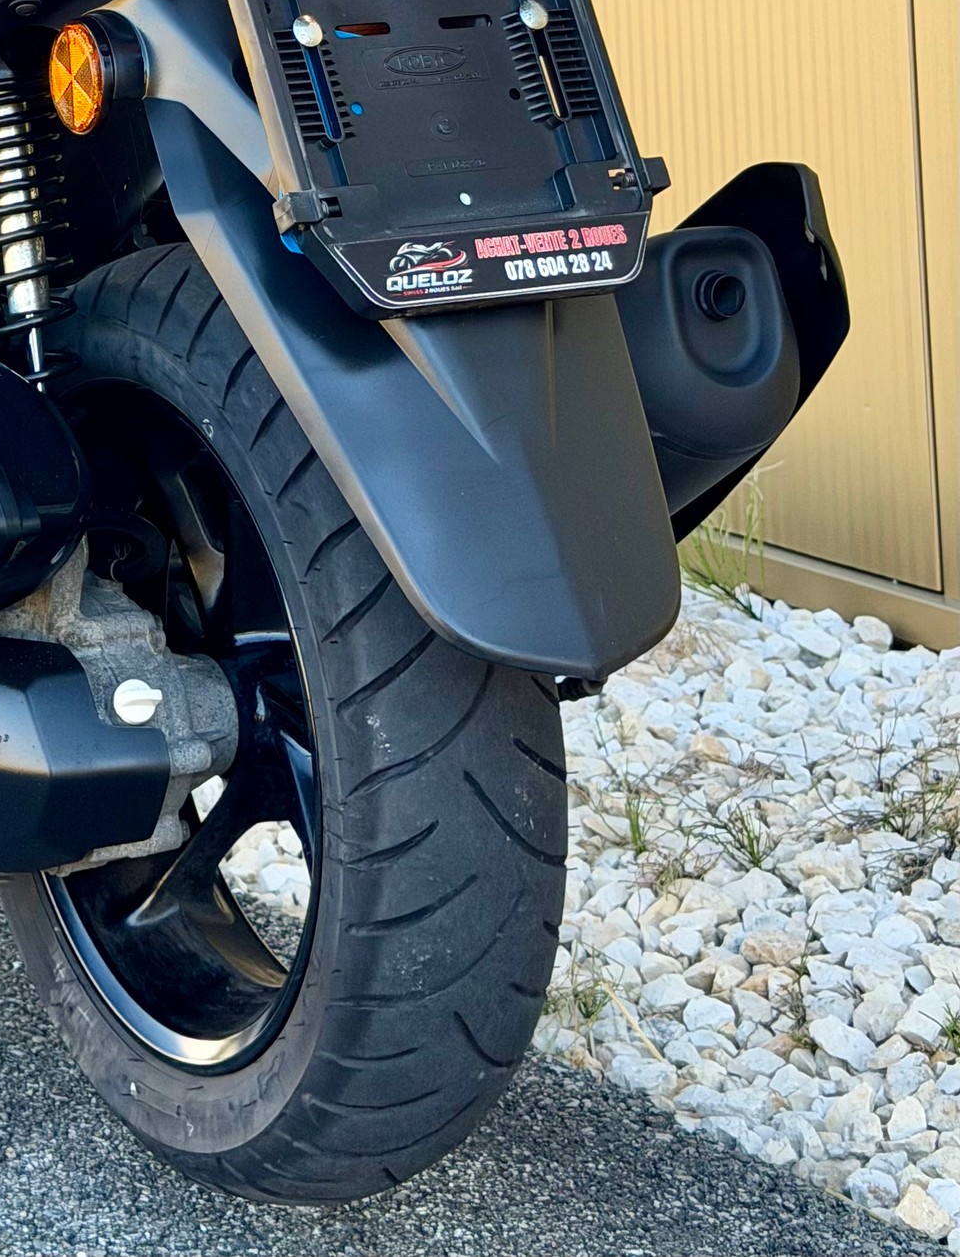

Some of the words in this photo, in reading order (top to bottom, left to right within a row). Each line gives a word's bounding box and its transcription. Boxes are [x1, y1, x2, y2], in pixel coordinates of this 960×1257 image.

[474, 230, 568, 259] ACHAT-VENTE
[568, 229, 582, 249] 2
[581, 224, 628, 248] ROUES
[386, 269, 473, 292] QUELOZ
[504, 259, 536, 281] 078
[536, 254, 568, 278] 604
[568, 252, 590, 274] 28
[591, 250, 613, 271] 24
